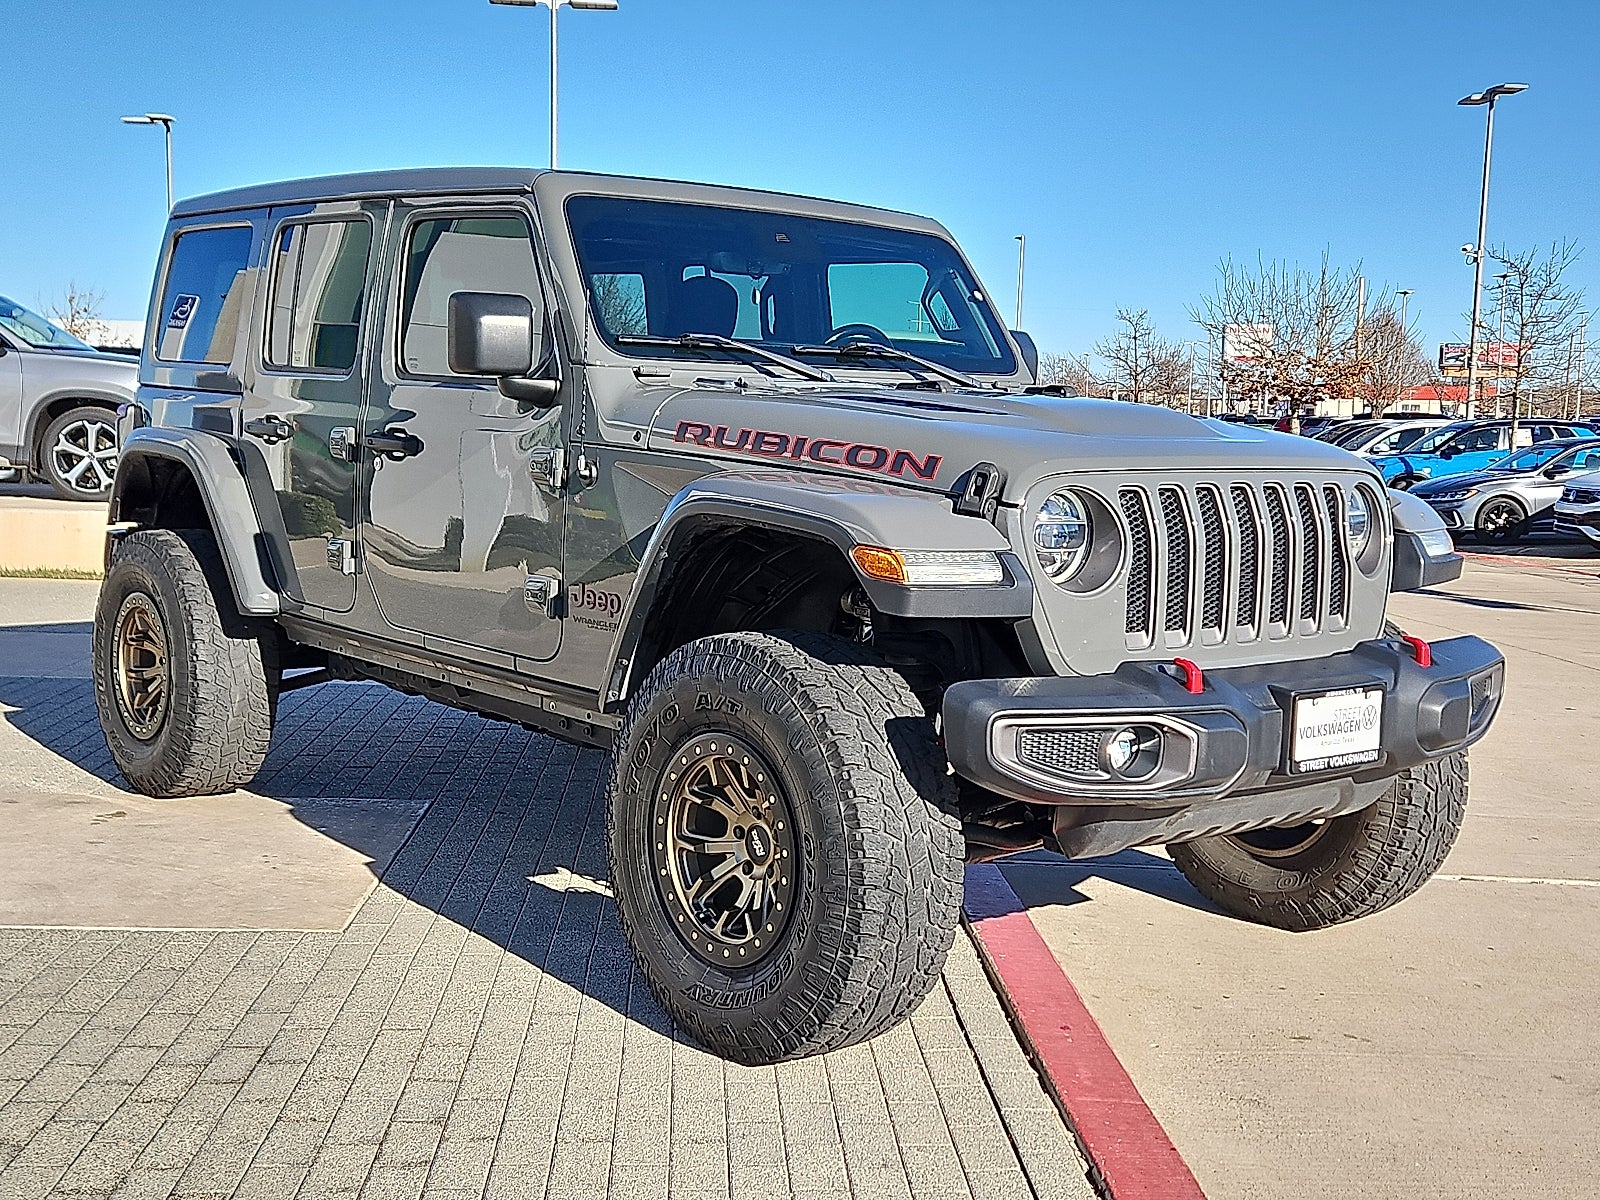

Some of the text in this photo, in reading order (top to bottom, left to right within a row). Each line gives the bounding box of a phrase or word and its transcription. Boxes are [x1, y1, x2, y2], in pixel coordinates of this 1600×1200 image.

[673, 420, 943, 481] RUBICON
[571, 582, 622, 619] Jeep
[694, 691, 743, 716] A/T
[1333, 706, 1362, 721] STREET
[1299, 720, 1361, 739] VOLKSWAGEN
[624, 701, 680, 795] TOYO
[1299, 750, 1379, 773] STREET VOLKSWAGEN
[679, 950, 794, 1010] COUNTRY
